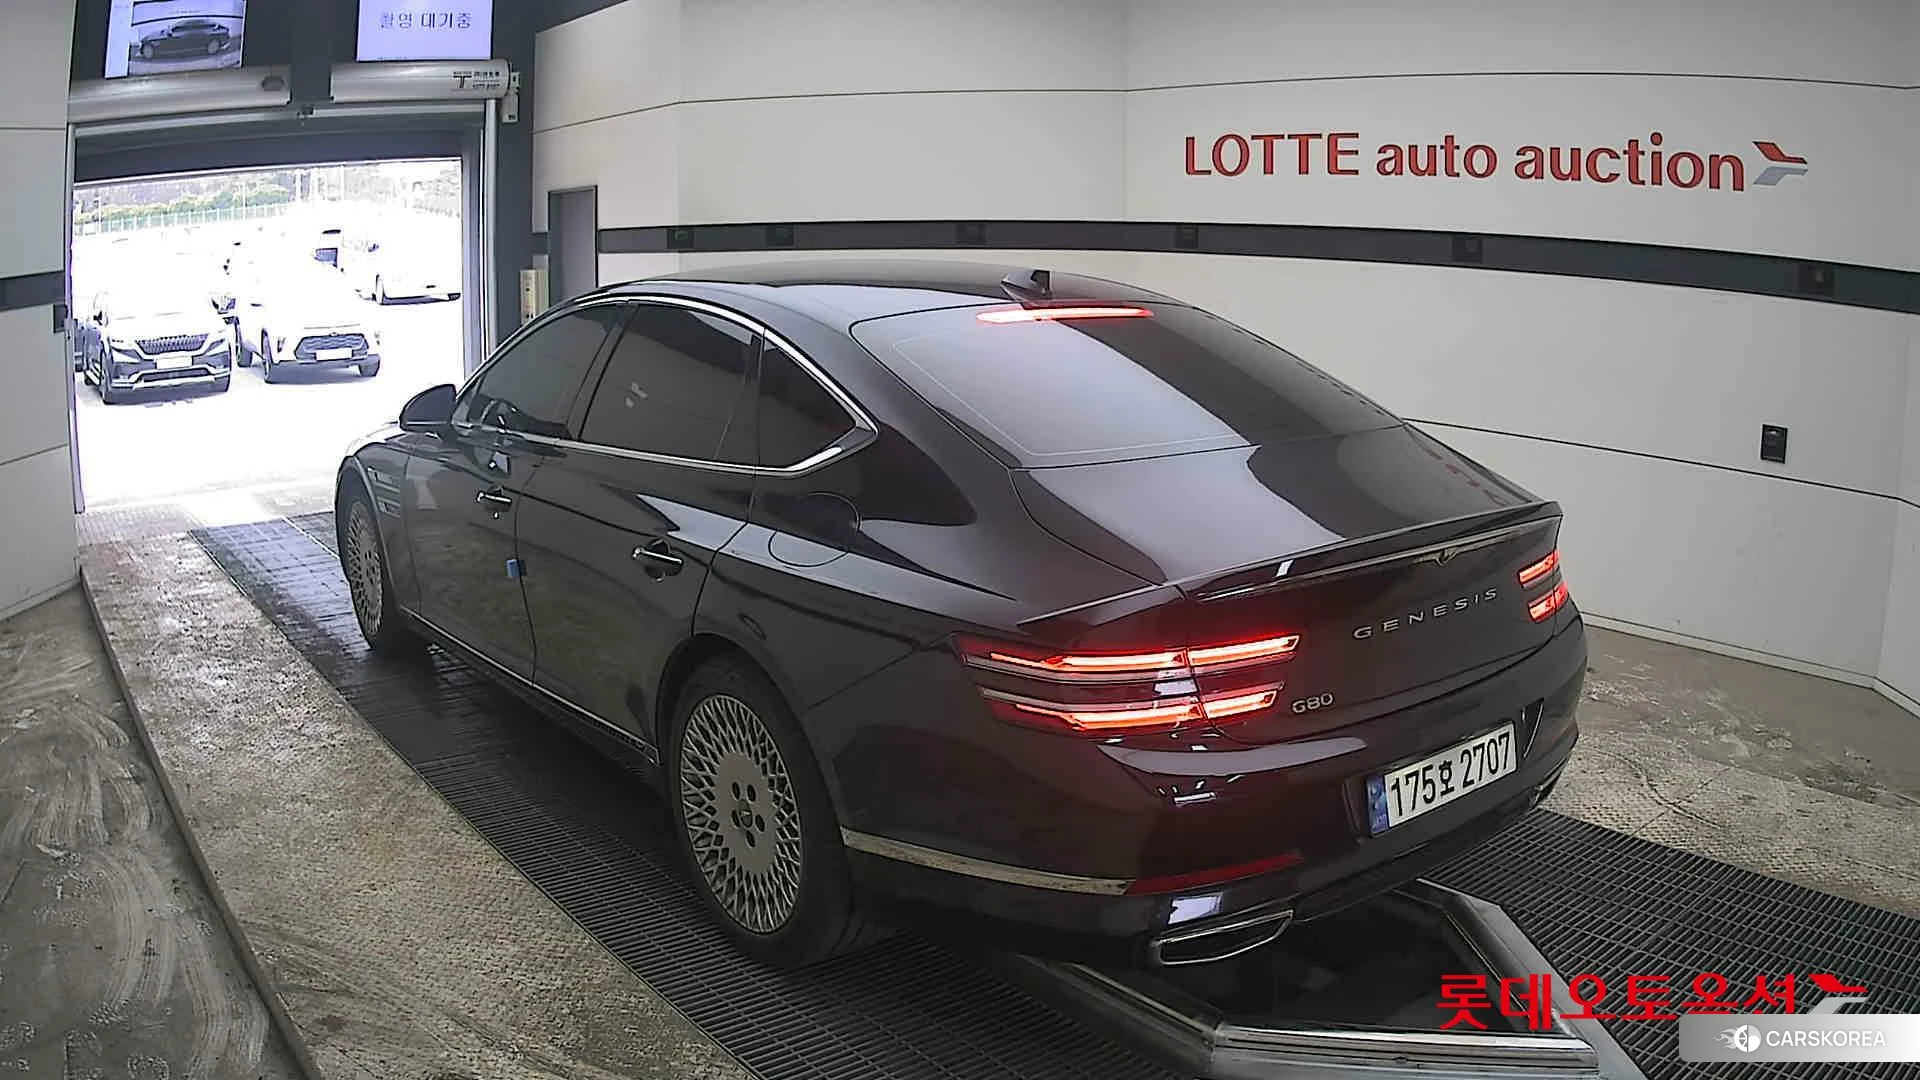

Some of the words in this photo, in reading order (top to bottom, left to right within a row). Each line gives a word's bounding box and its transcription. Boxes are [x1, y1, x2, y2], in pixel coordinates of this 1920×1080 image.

[1185, 132, 1360, 177] LOTTE
[1376, 135, 1498, 178] auto
[1514, 132, 1745, 192] auction
[1353, 587, 1498, 640] GENESIS
[1291, 693, 1335, 714] G80
[1390, 759, 1454, 817] 175호
[1460, 732, 1511, 789] 2707
